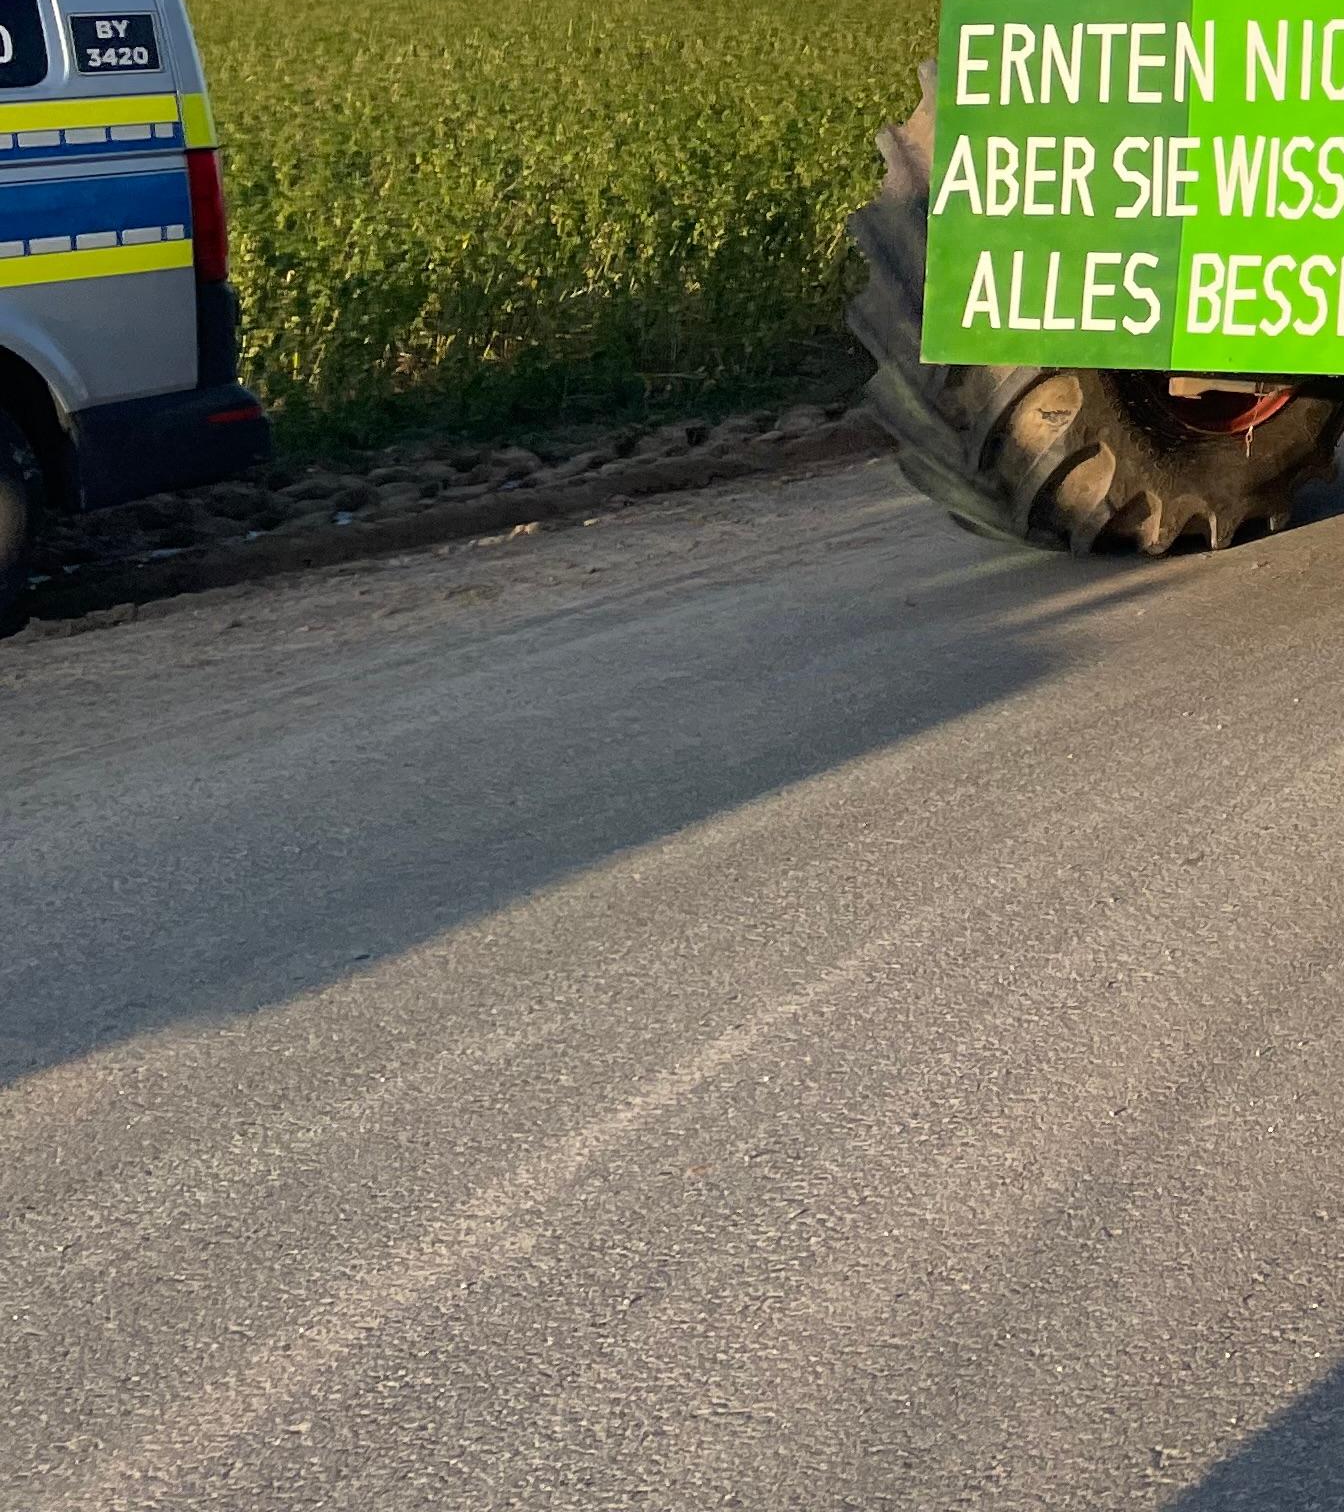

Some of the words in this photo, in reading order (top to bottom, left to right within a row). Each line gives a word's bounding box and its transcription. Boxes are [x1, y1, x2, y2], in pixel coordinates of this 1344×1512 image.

[86, 46, 149, 68] 3420
[95, 20, 130, 39] BY
[955, 19, 1215, 105] ERNTEN
[932, 135, 1095, 217] ABER
[1113, 136, 1201, 219] SIE
[961, 250, 1161, 335] ALLES
